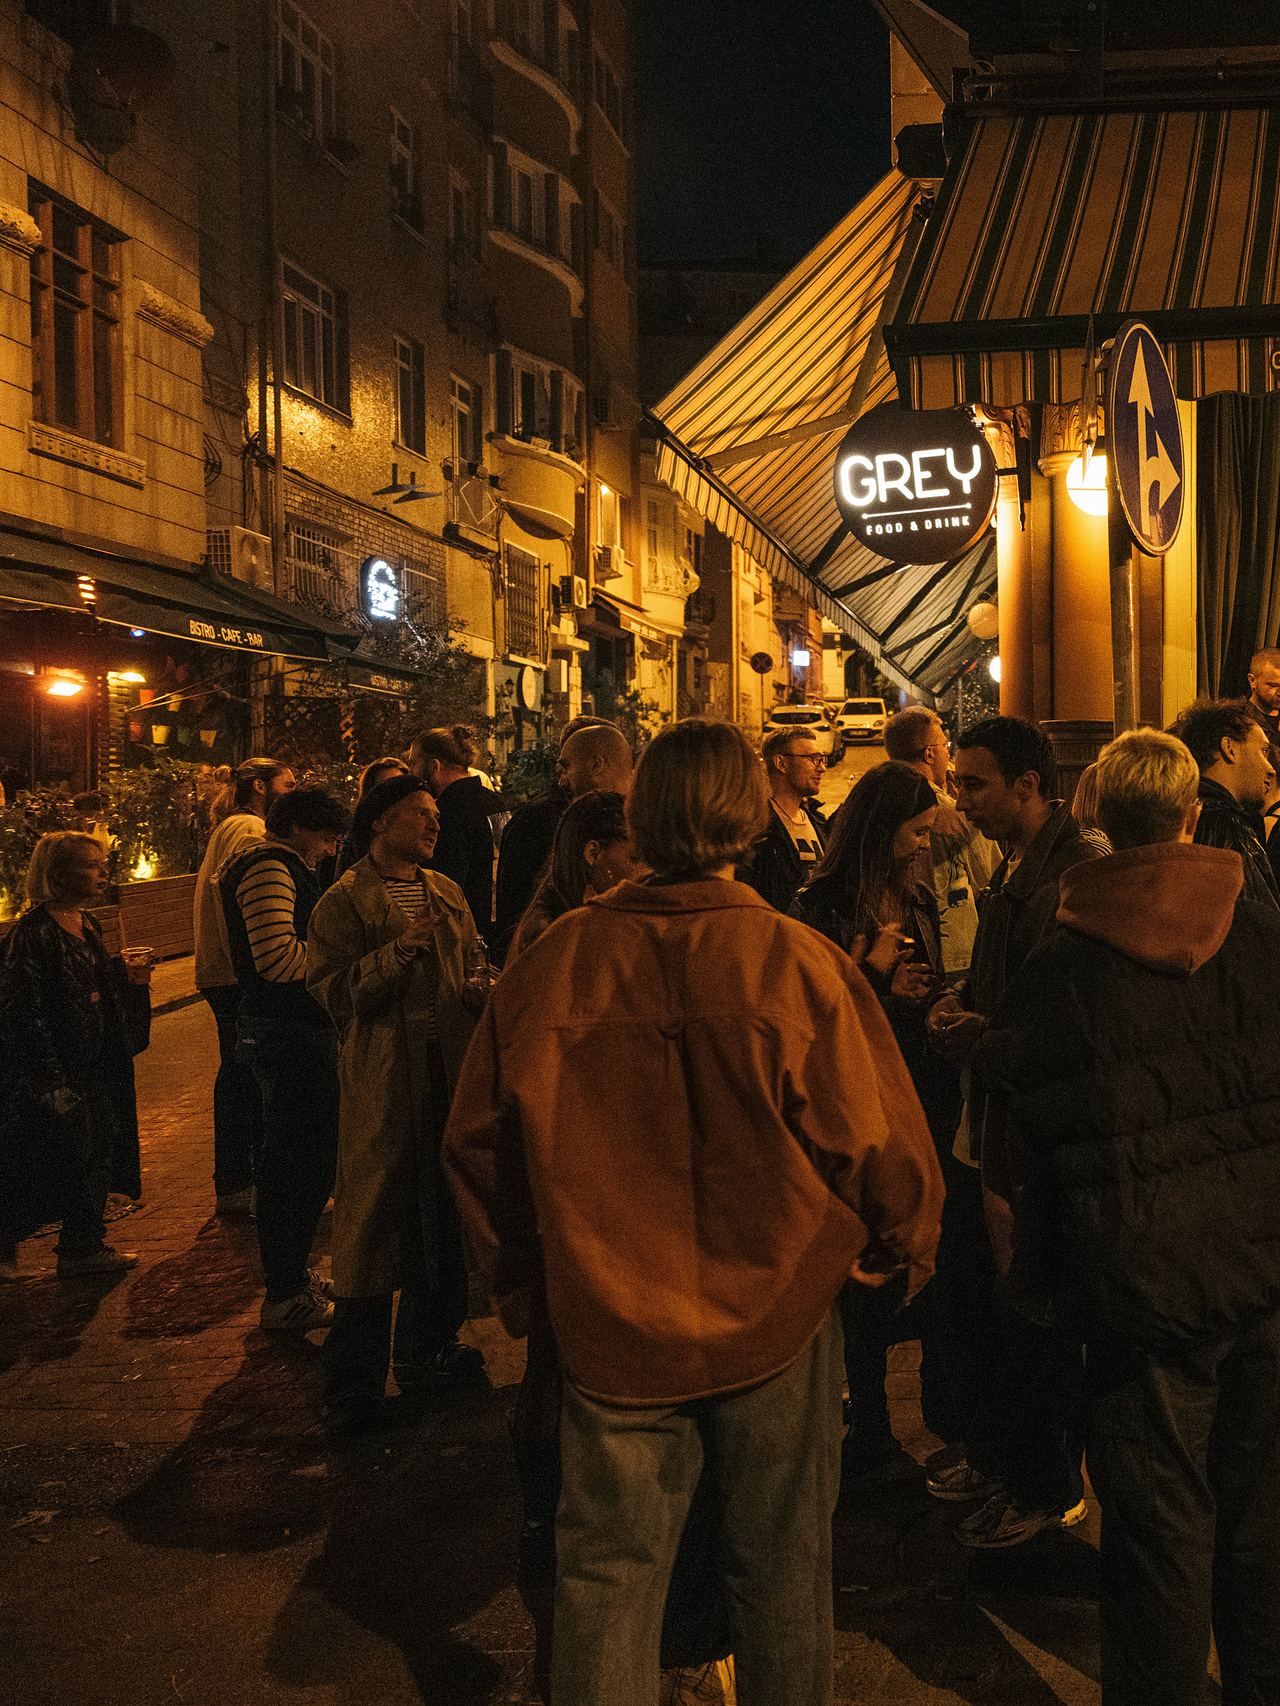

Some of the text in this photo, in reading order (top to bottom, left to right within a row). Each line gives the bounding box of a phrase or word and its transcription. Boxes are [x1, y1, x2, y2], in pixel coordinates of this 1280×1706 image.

[840, 444, 982, 507] GREY
[866, 515, 970, 536] FOOD & DRINK
[189, 619, 216, 640] BISTRO
[221, 627, 243, 644] CAFE
[247, 632, 263, 647] BAR
